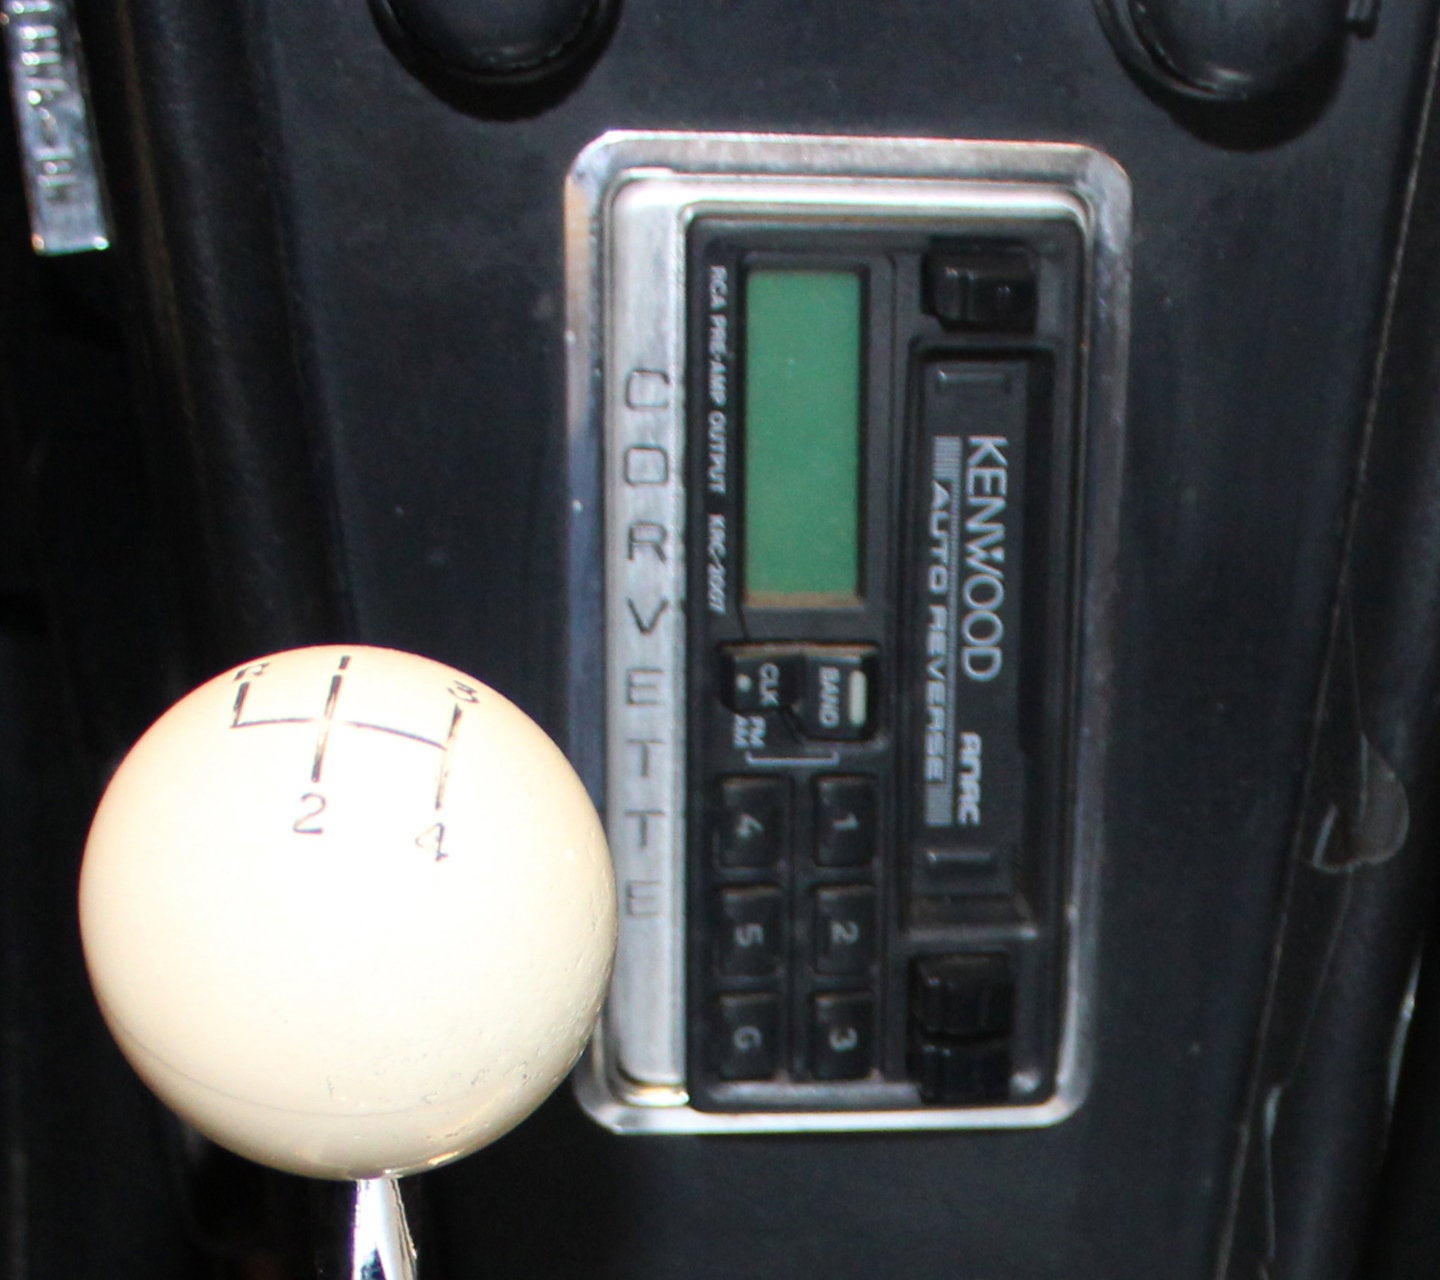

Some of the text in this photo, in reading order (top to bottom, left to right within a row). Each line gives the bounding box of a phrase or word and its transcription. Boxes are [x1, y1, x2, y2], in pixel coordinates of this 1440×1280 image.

[708, 265, 728, 309] RCA
[707, 410, 727, 495] OUTPUT
[960, 434, 1008, 682] KENWOOD
[623, 367, 671, 919] CORVETTE
[925, 480, 950, 783] AUTO REVERSE
[759, 663, 780, 706] CLK
[819, 666, 840, 728] BAND
[292, 791, 327, 835] 2
[735, 813, 763, 839] 4
[832, 812, 859, 831] 1
[733, 922, 764, 948] 5
[830, 920, 859, 945] 2
[733, 1025, 762, 1051] 6
[829, 1026, 858, 1051] 3
